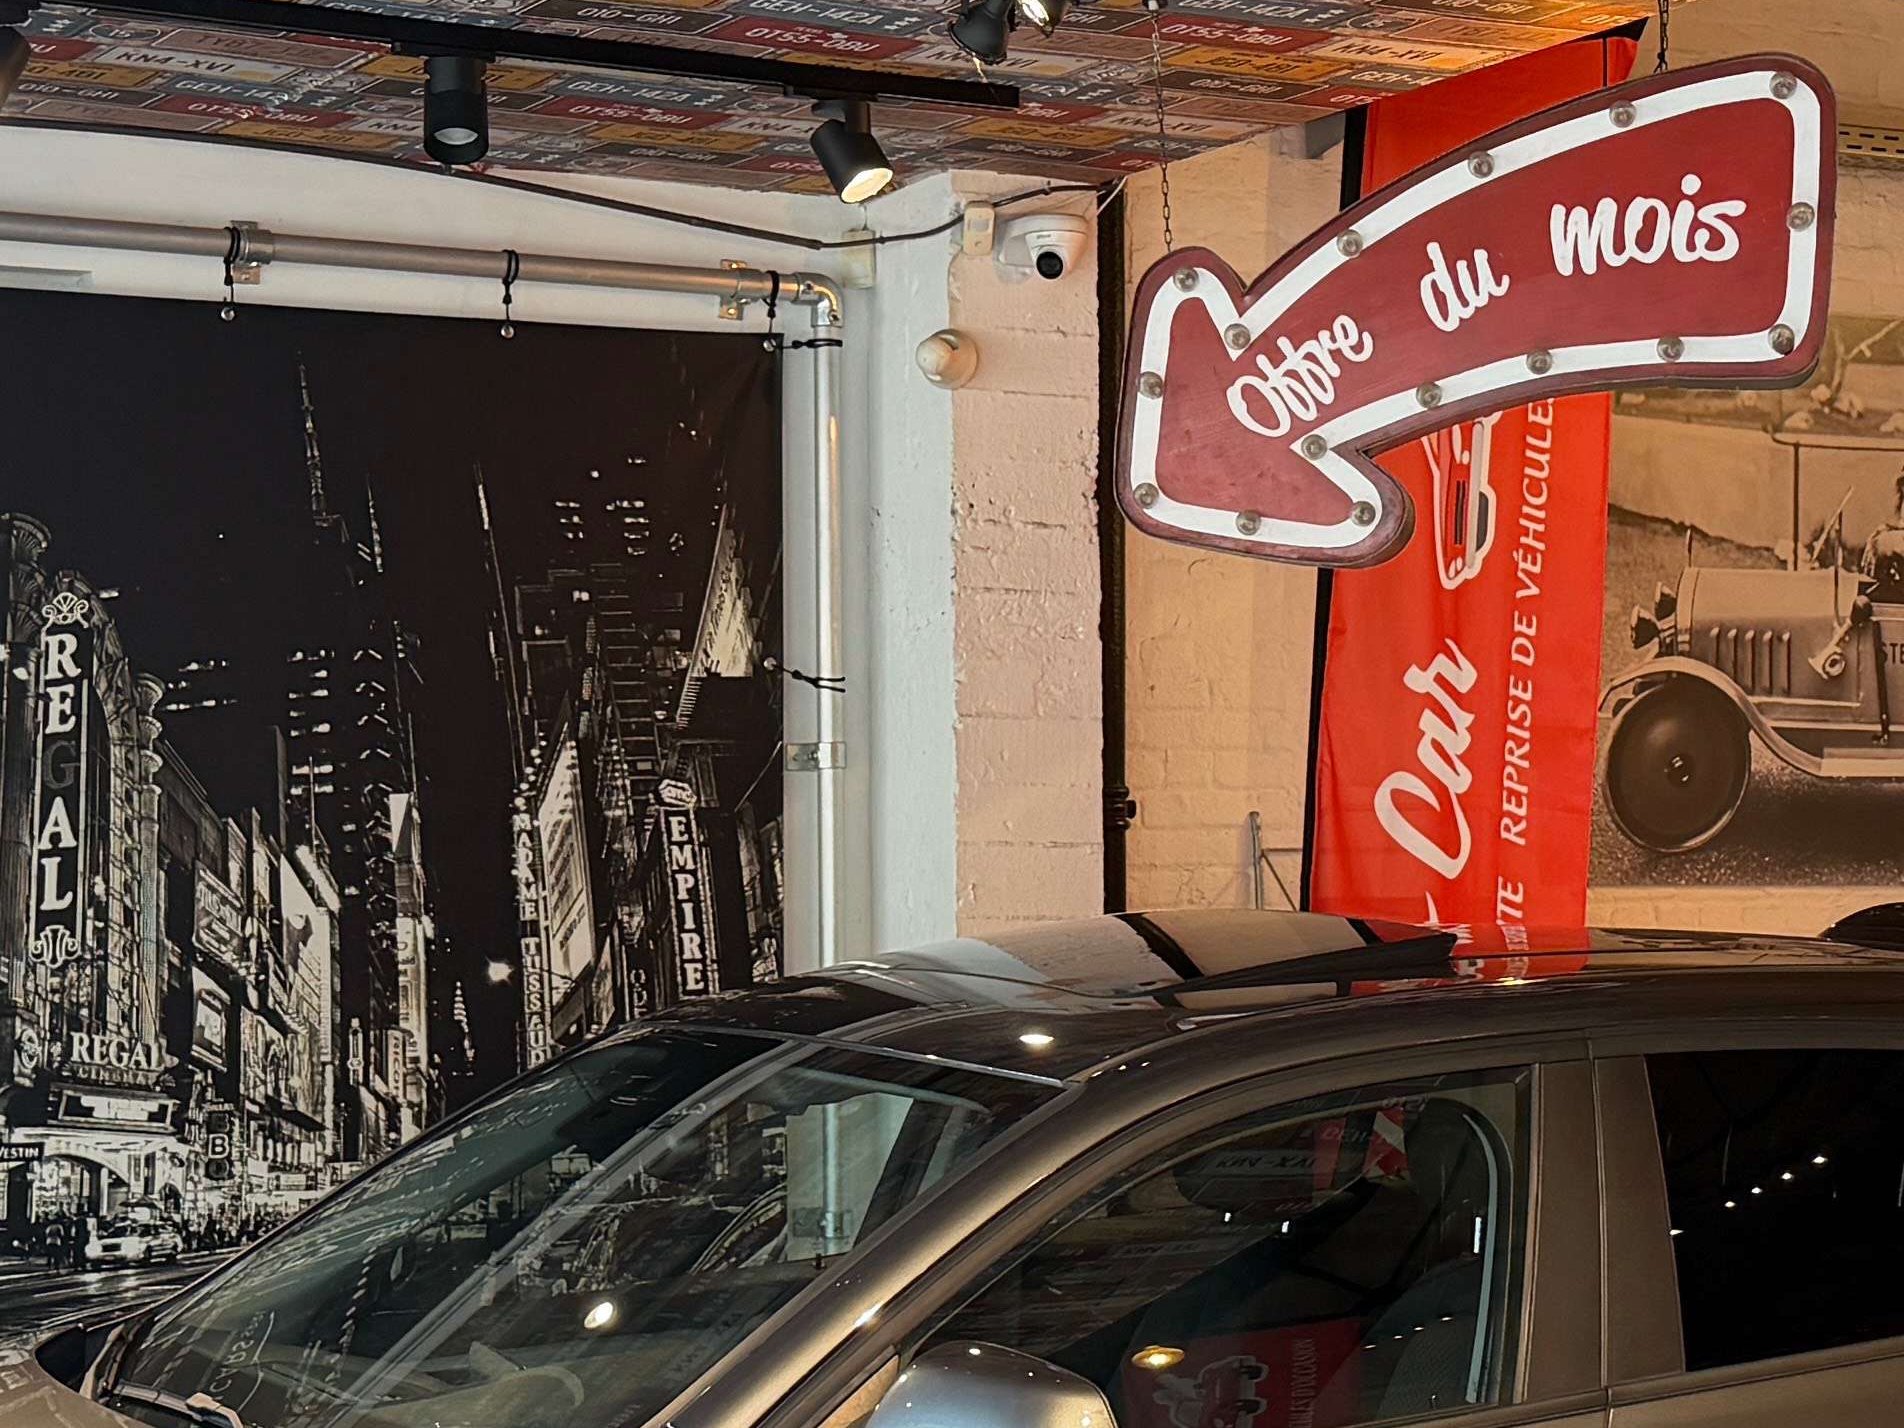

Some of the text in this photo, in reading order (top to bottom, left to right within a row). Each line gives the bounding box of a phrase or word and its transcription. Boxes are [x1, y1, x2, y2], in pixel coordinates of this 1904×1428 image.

[1226, 173, 1747, 439] Offre du mois
[1509, 613, 1537, 670] DE
[40, 631, 82, 913] REGAL
[1374, 636, 1478, 879] Car
[1500, 679, 1534, 846] REPRISE
[669, 816, 704, 990] EMPIRE
